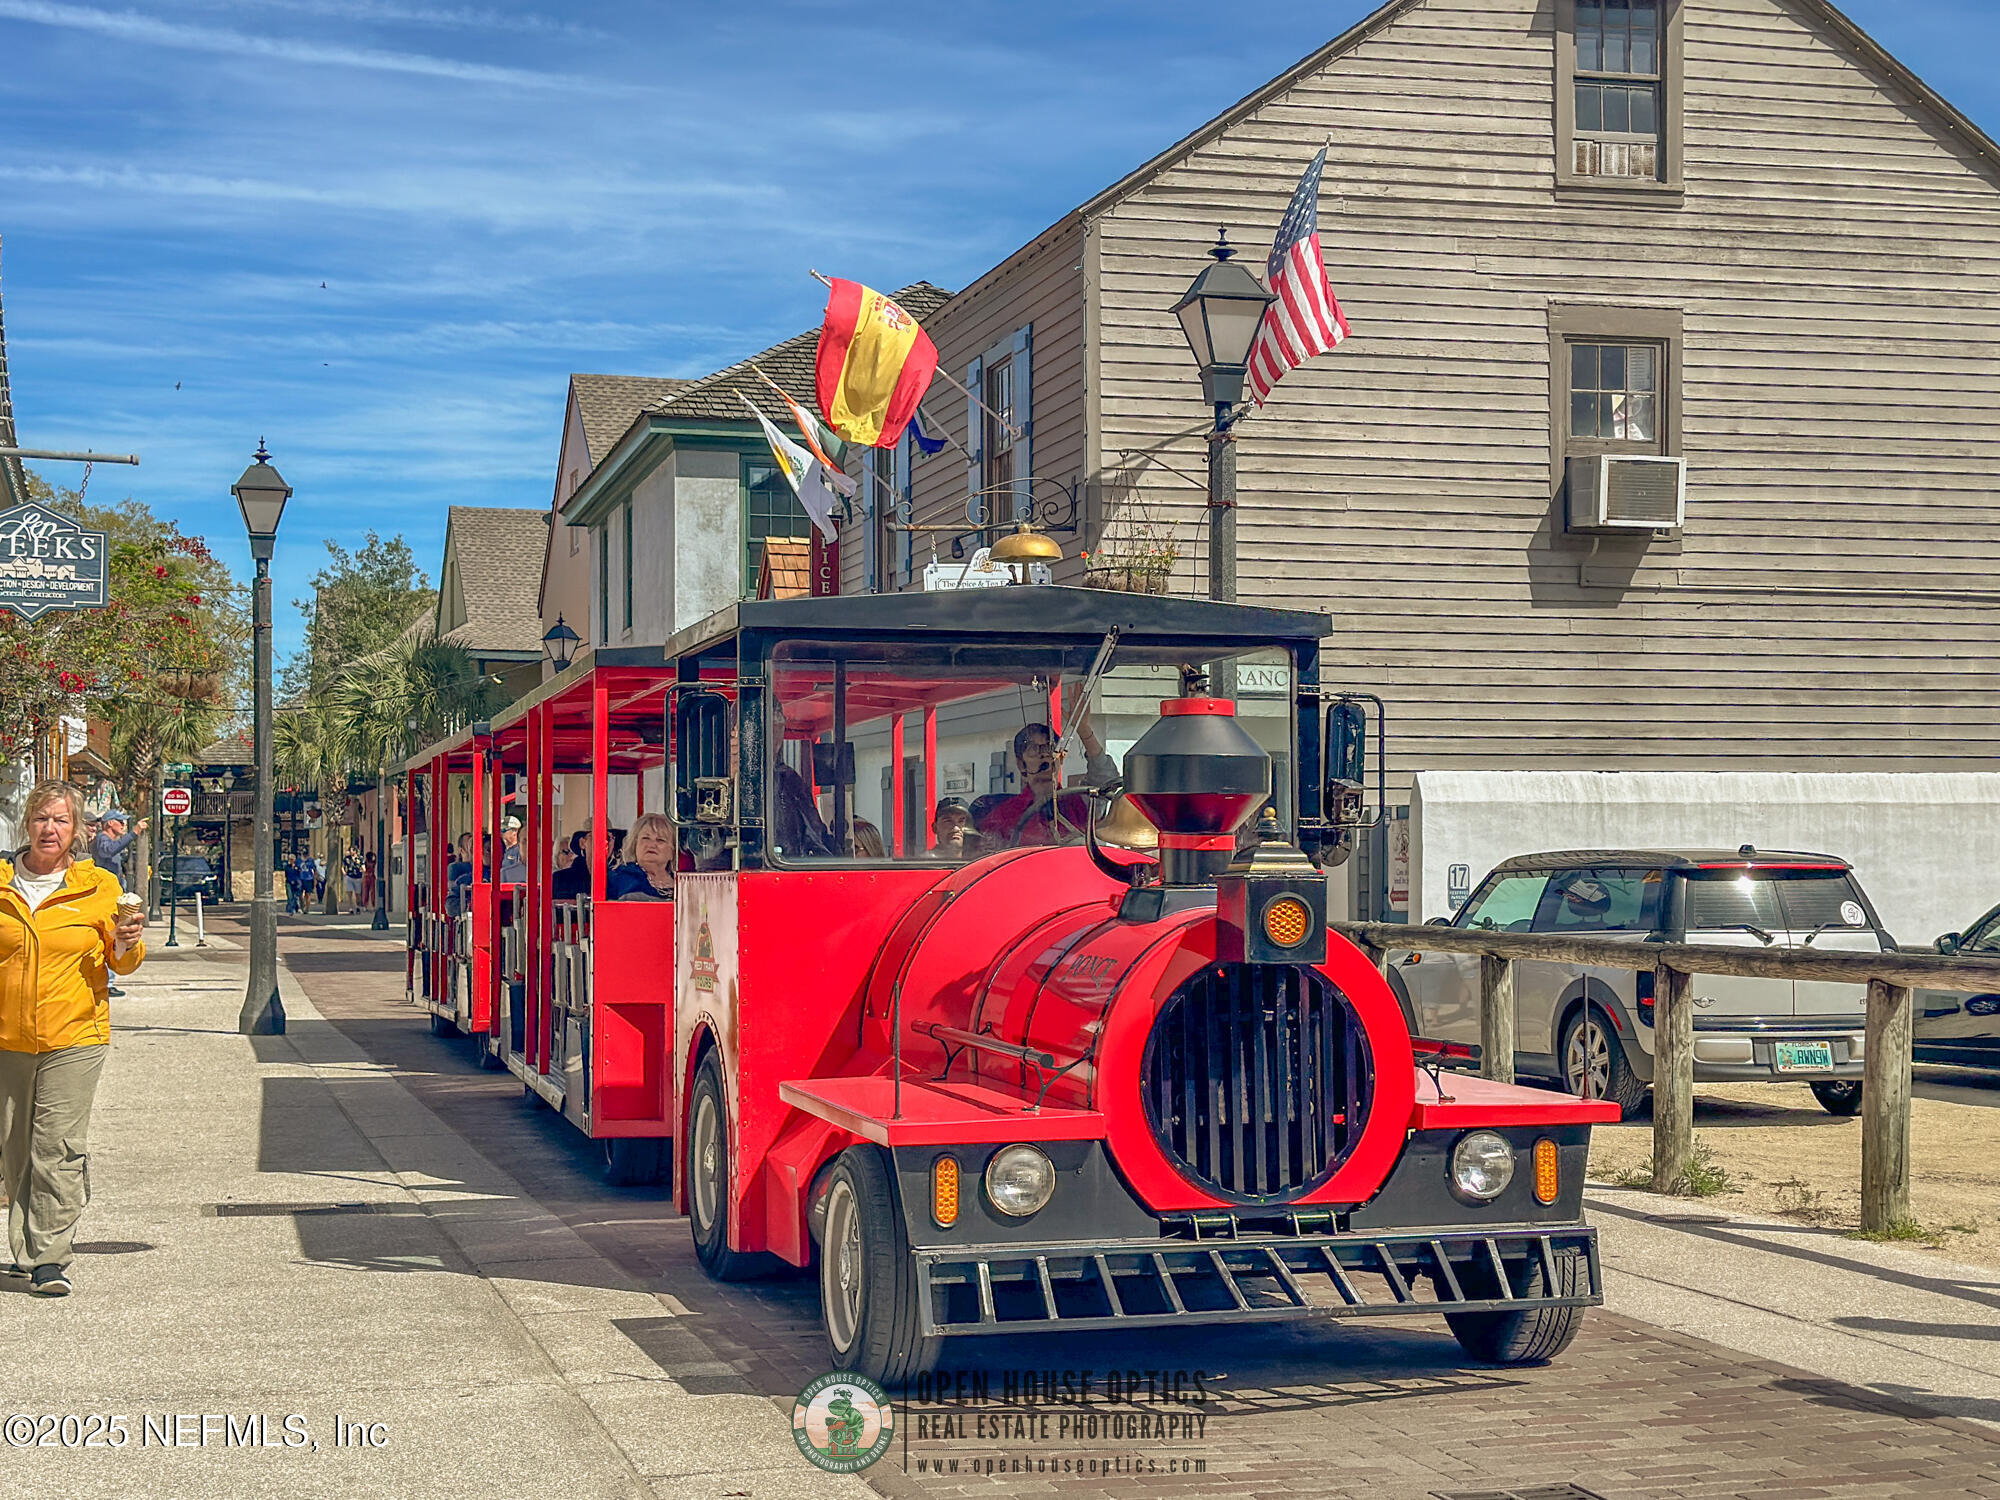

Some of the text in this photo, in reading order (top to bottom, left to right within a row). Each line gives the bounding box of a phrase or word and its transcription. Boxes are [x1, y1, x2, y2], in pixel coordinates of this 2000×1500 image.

[0, 534, 96, 560] EEKS
[49, 581, 95, 592] DEVELOPMENT
[942, 580, 956, 588] The
[1451, 867, 1467, 887] 17
